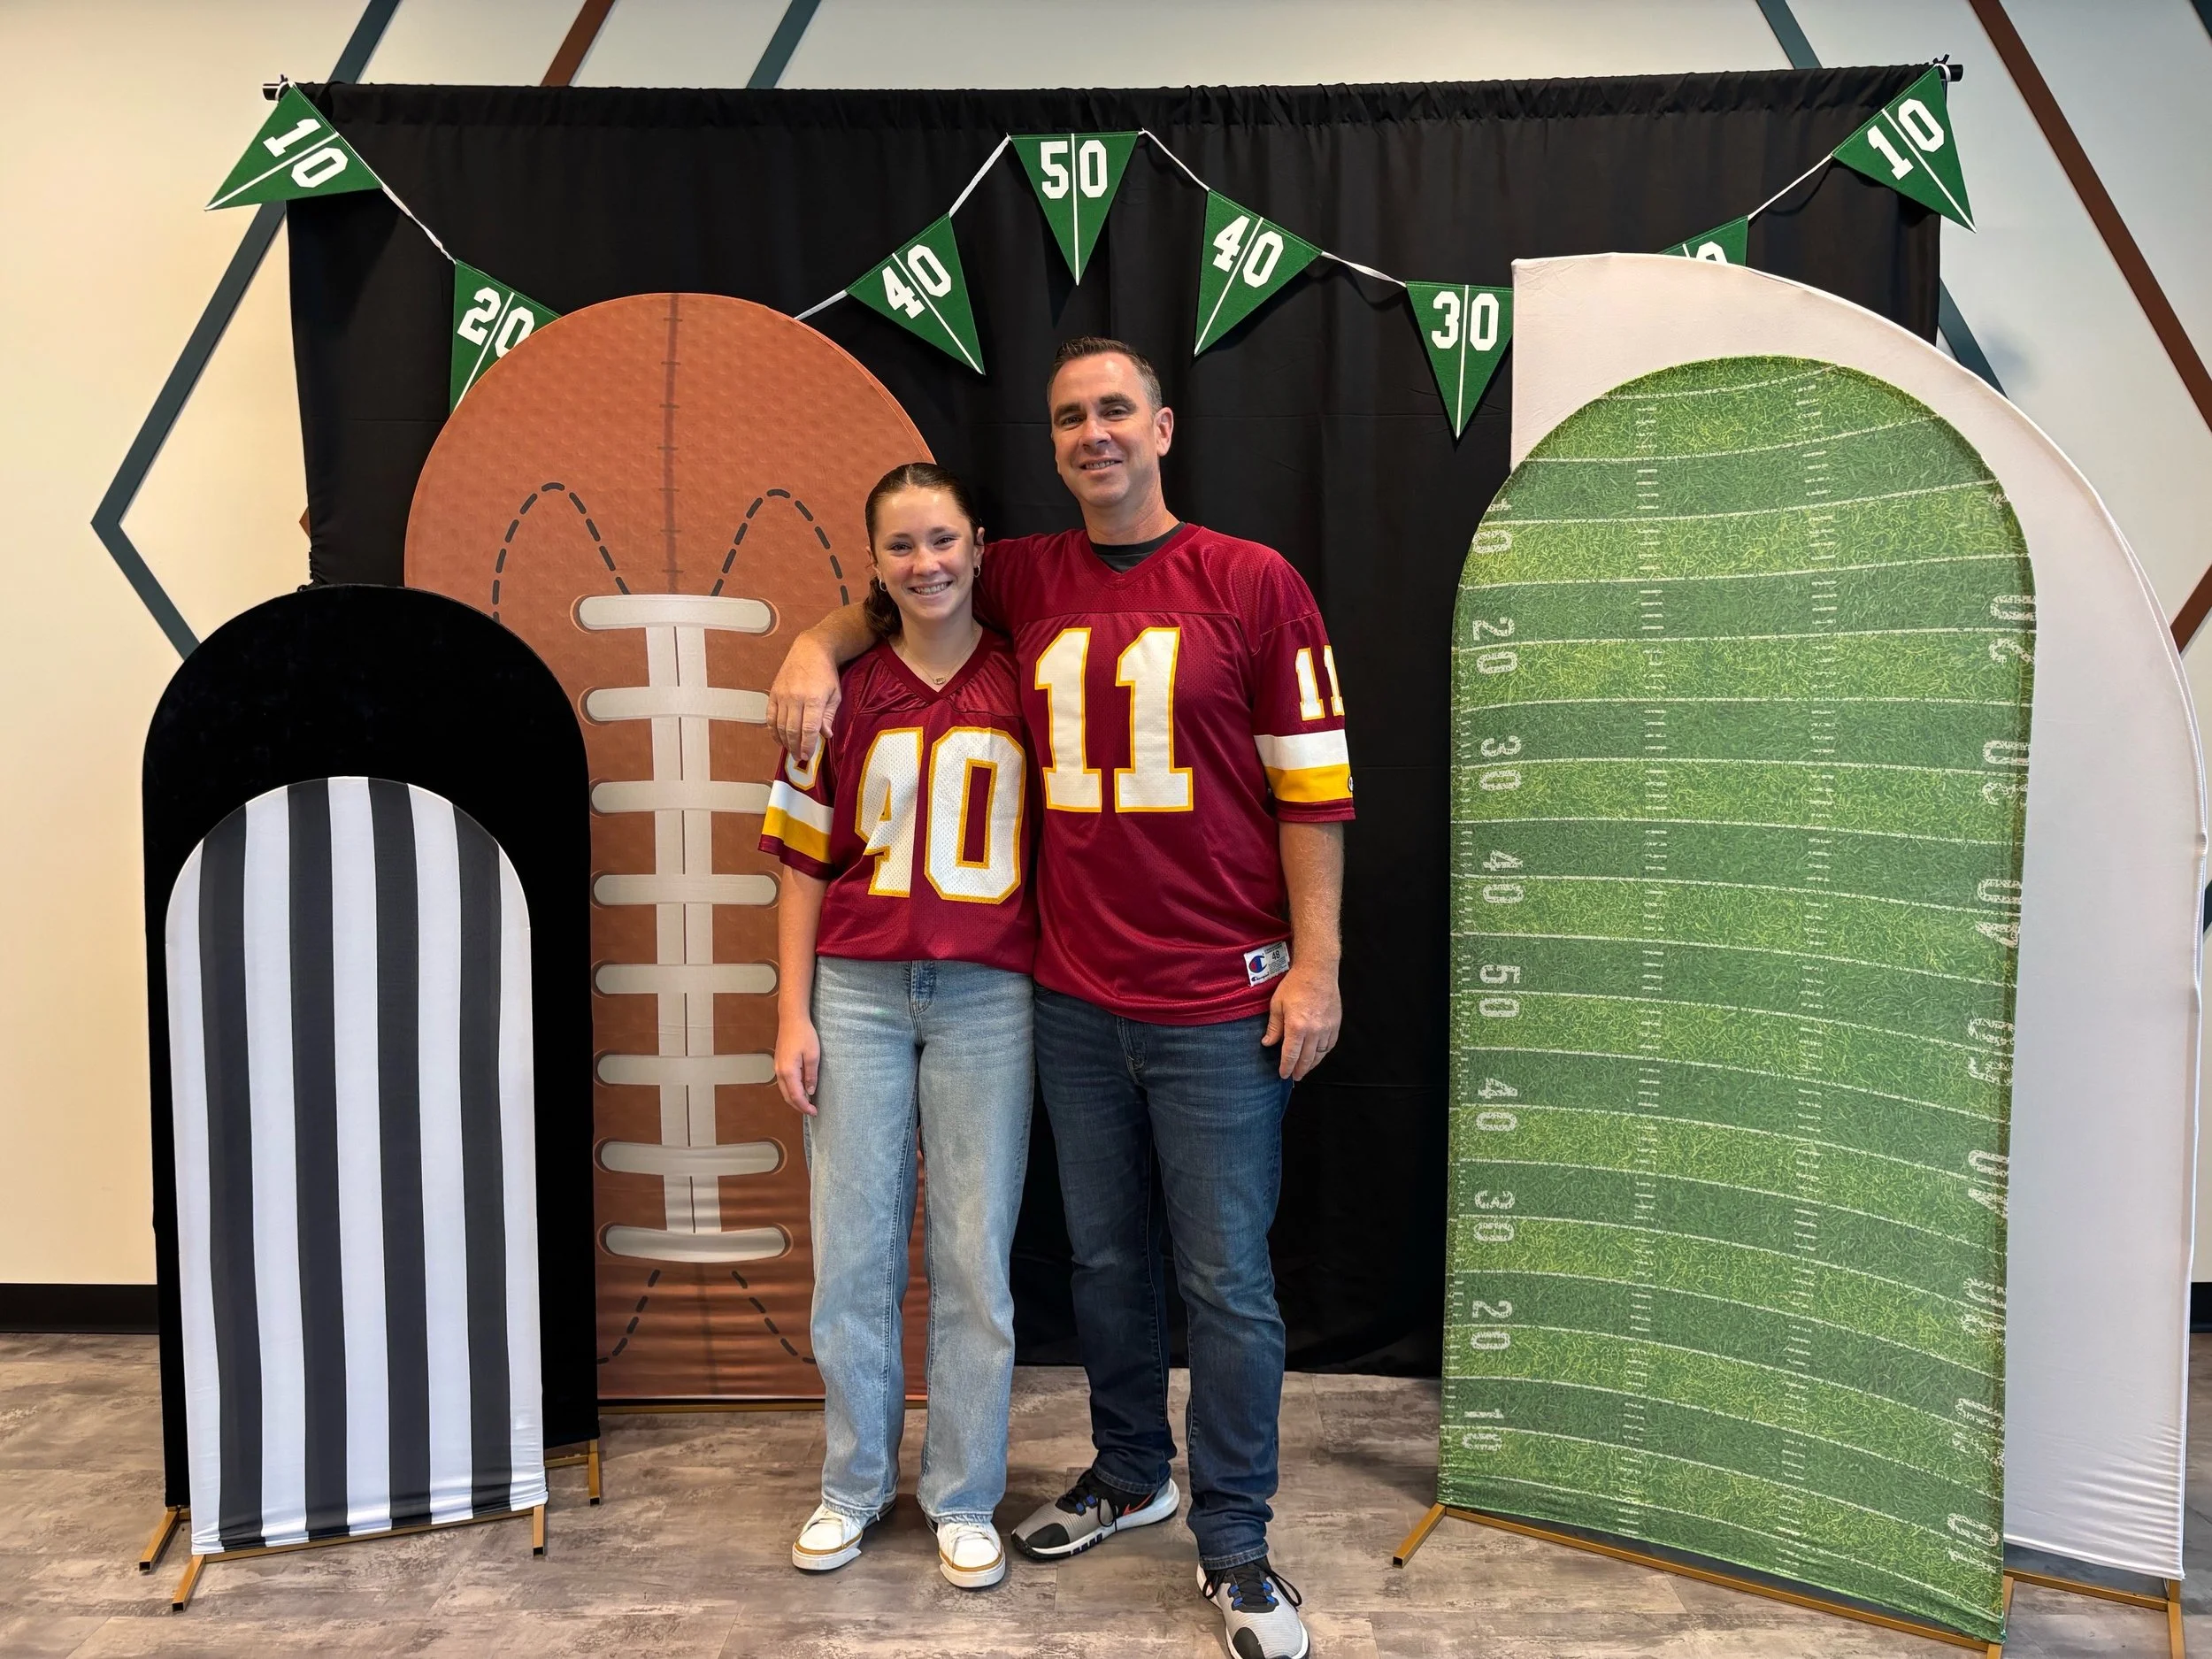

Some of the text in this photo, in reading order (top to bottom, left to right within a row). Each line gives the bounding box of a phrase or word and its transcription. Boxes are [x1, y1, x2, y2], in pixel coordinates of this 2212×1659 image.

[263, 119, 349, 188] 10
[1867, 98, 1945, 180] 10
[1040, 139, 1108, 200] 50
[882, 244, 952, 319] 40
[1211, 215, 1285, 288] 40
[457, 287, 535, 358] 20
[1432, 291, 1500, 351] 30
[1472, 617, 1517, 674] 20
[1295, 645, 1345, 721] 11
[1034, 626, 1194, 812] 11
[1479, 735, 1522, 792] 30
[855, 726, 1025, 904] 40
[1482, 849, 1525, 903] 40
[1271, 950, 1280, 960] 48
[1479, 964, 1521, 1018] 50
[1476, 1078, 1517, 1132] 40
[1473, 1190, 1516, 1242] 30
[1471, 1300, 1512, 1350] 20
[1462, 1409, 1504, 1451] 10
[1946, 1513, 1999, 1574] 10
